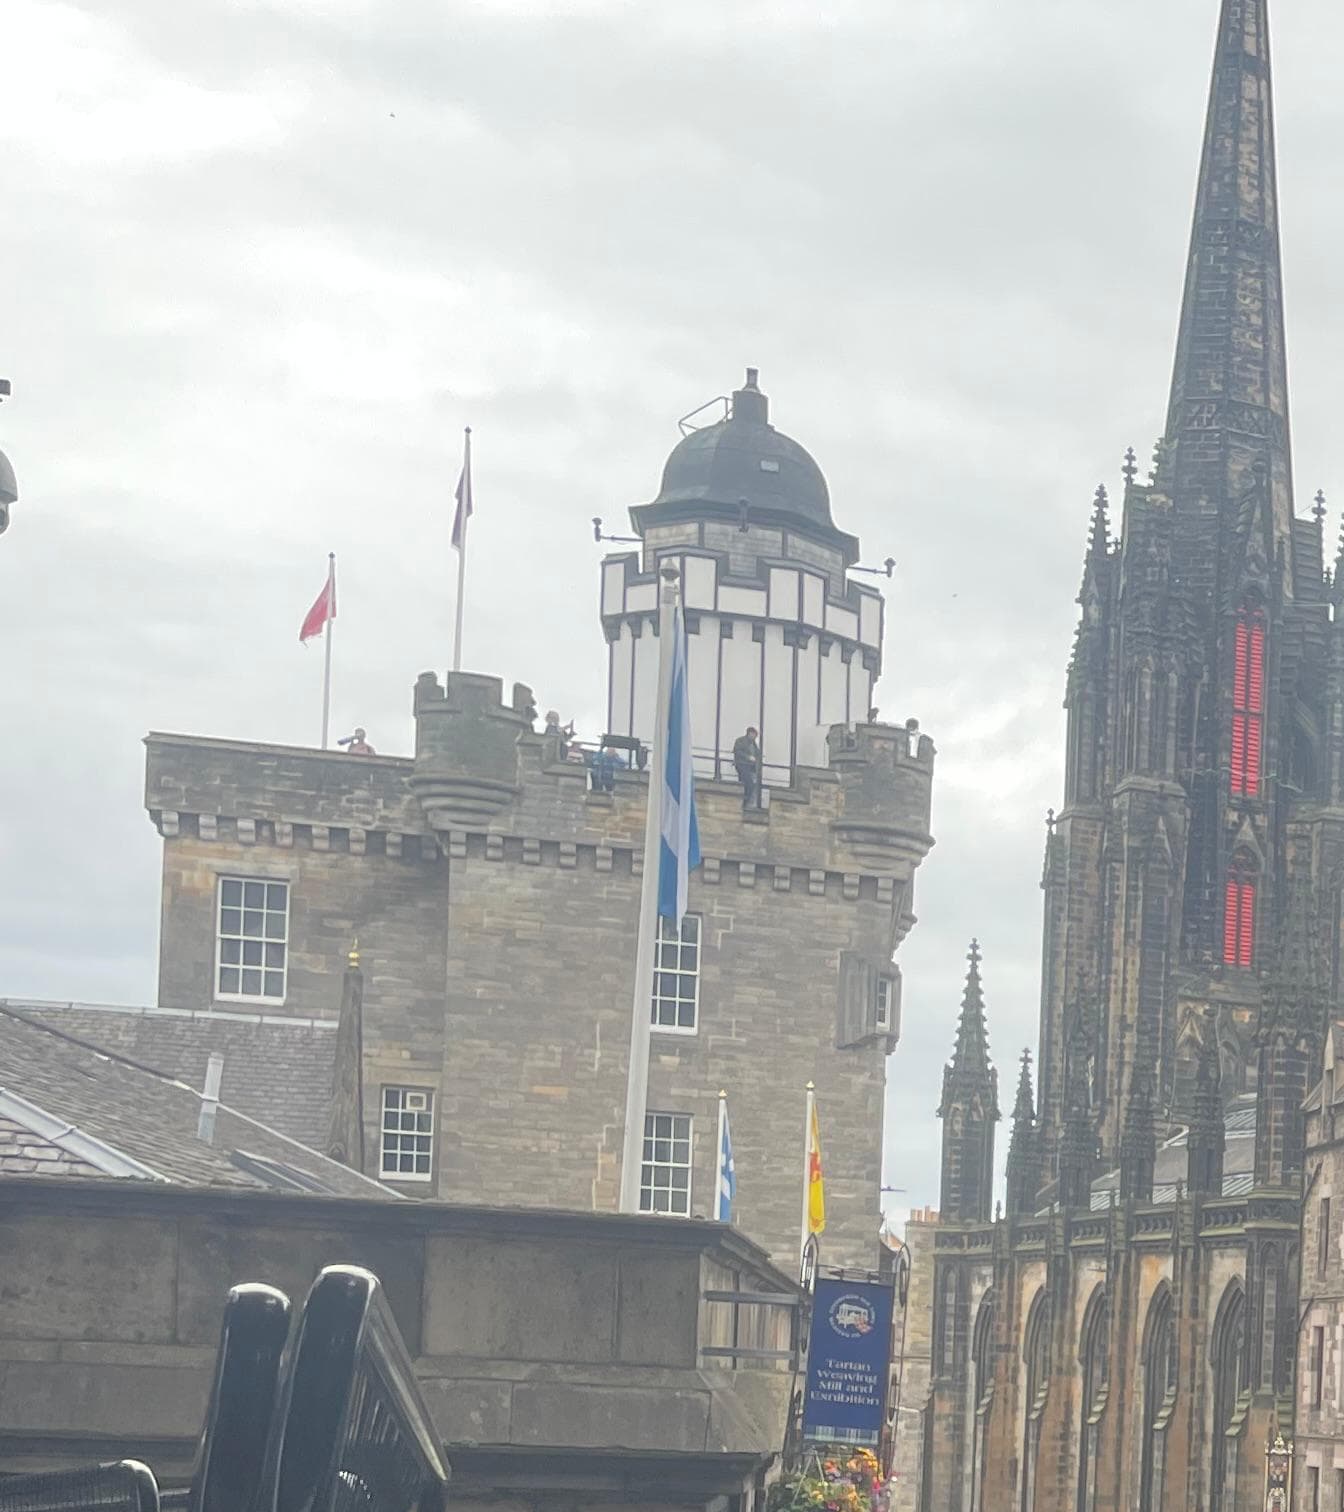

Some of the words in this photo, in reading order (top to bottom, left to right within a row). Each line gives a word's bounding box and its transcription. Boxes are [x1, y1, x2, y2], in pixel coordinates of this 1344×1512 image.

[825, 1358, 871, 1371] Tartan
[817, 1369, 878, 1385] Weaving
[819, 1380, 842, 1391] Mill
[846, 1383, 873, 1394] and
[810, 1391, 880, 1406] Exhibition
